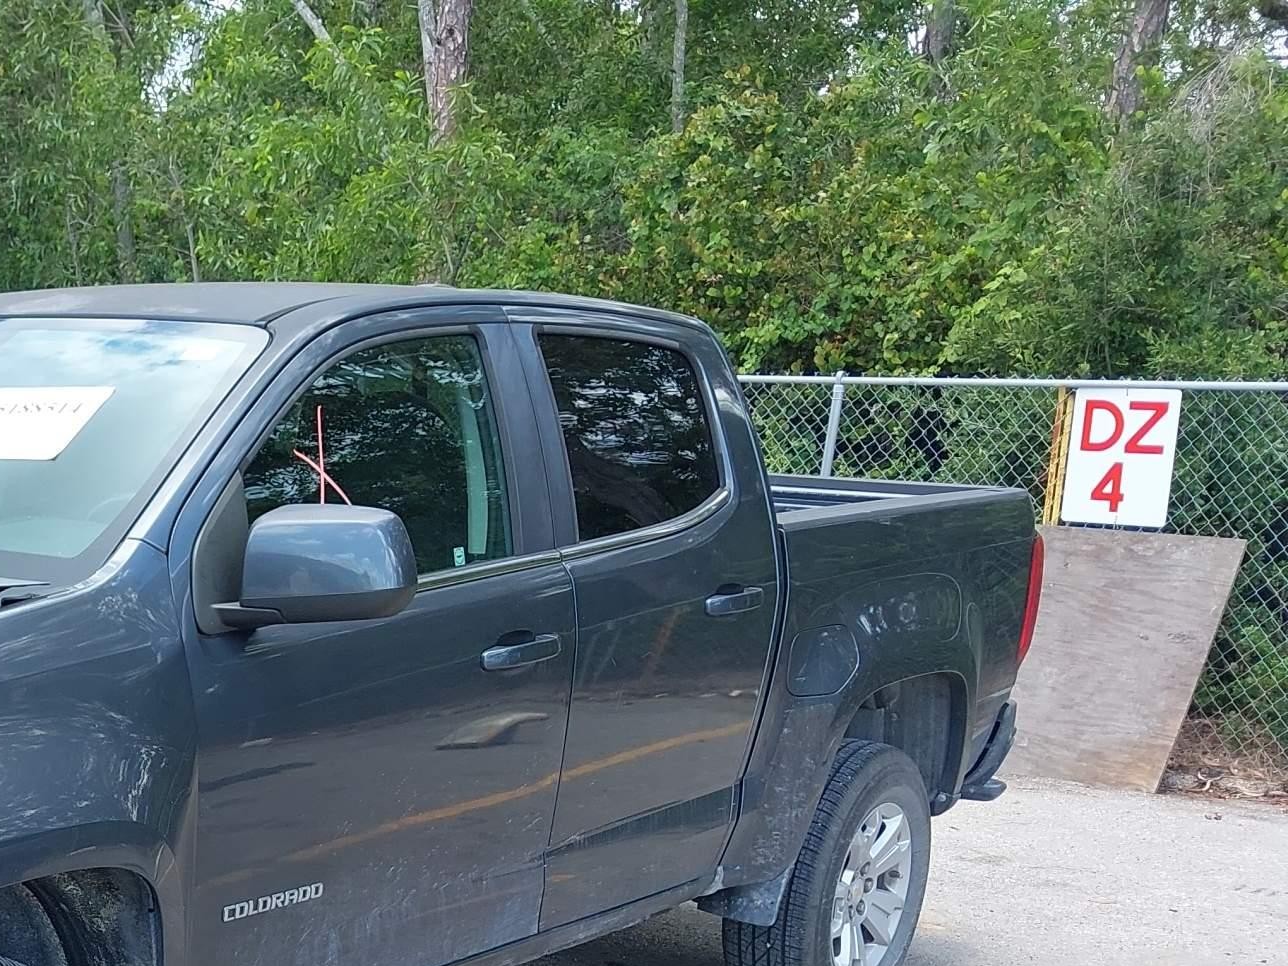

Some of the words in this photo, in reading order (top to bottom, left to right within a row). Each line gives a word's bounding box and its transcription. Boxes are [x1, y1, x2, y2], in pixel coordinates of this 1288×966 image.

[1080, 399, 1170, 455] DZ
[1090, 462, 1124, 512] 4
[222, 882, 324, 923] COLORADO
